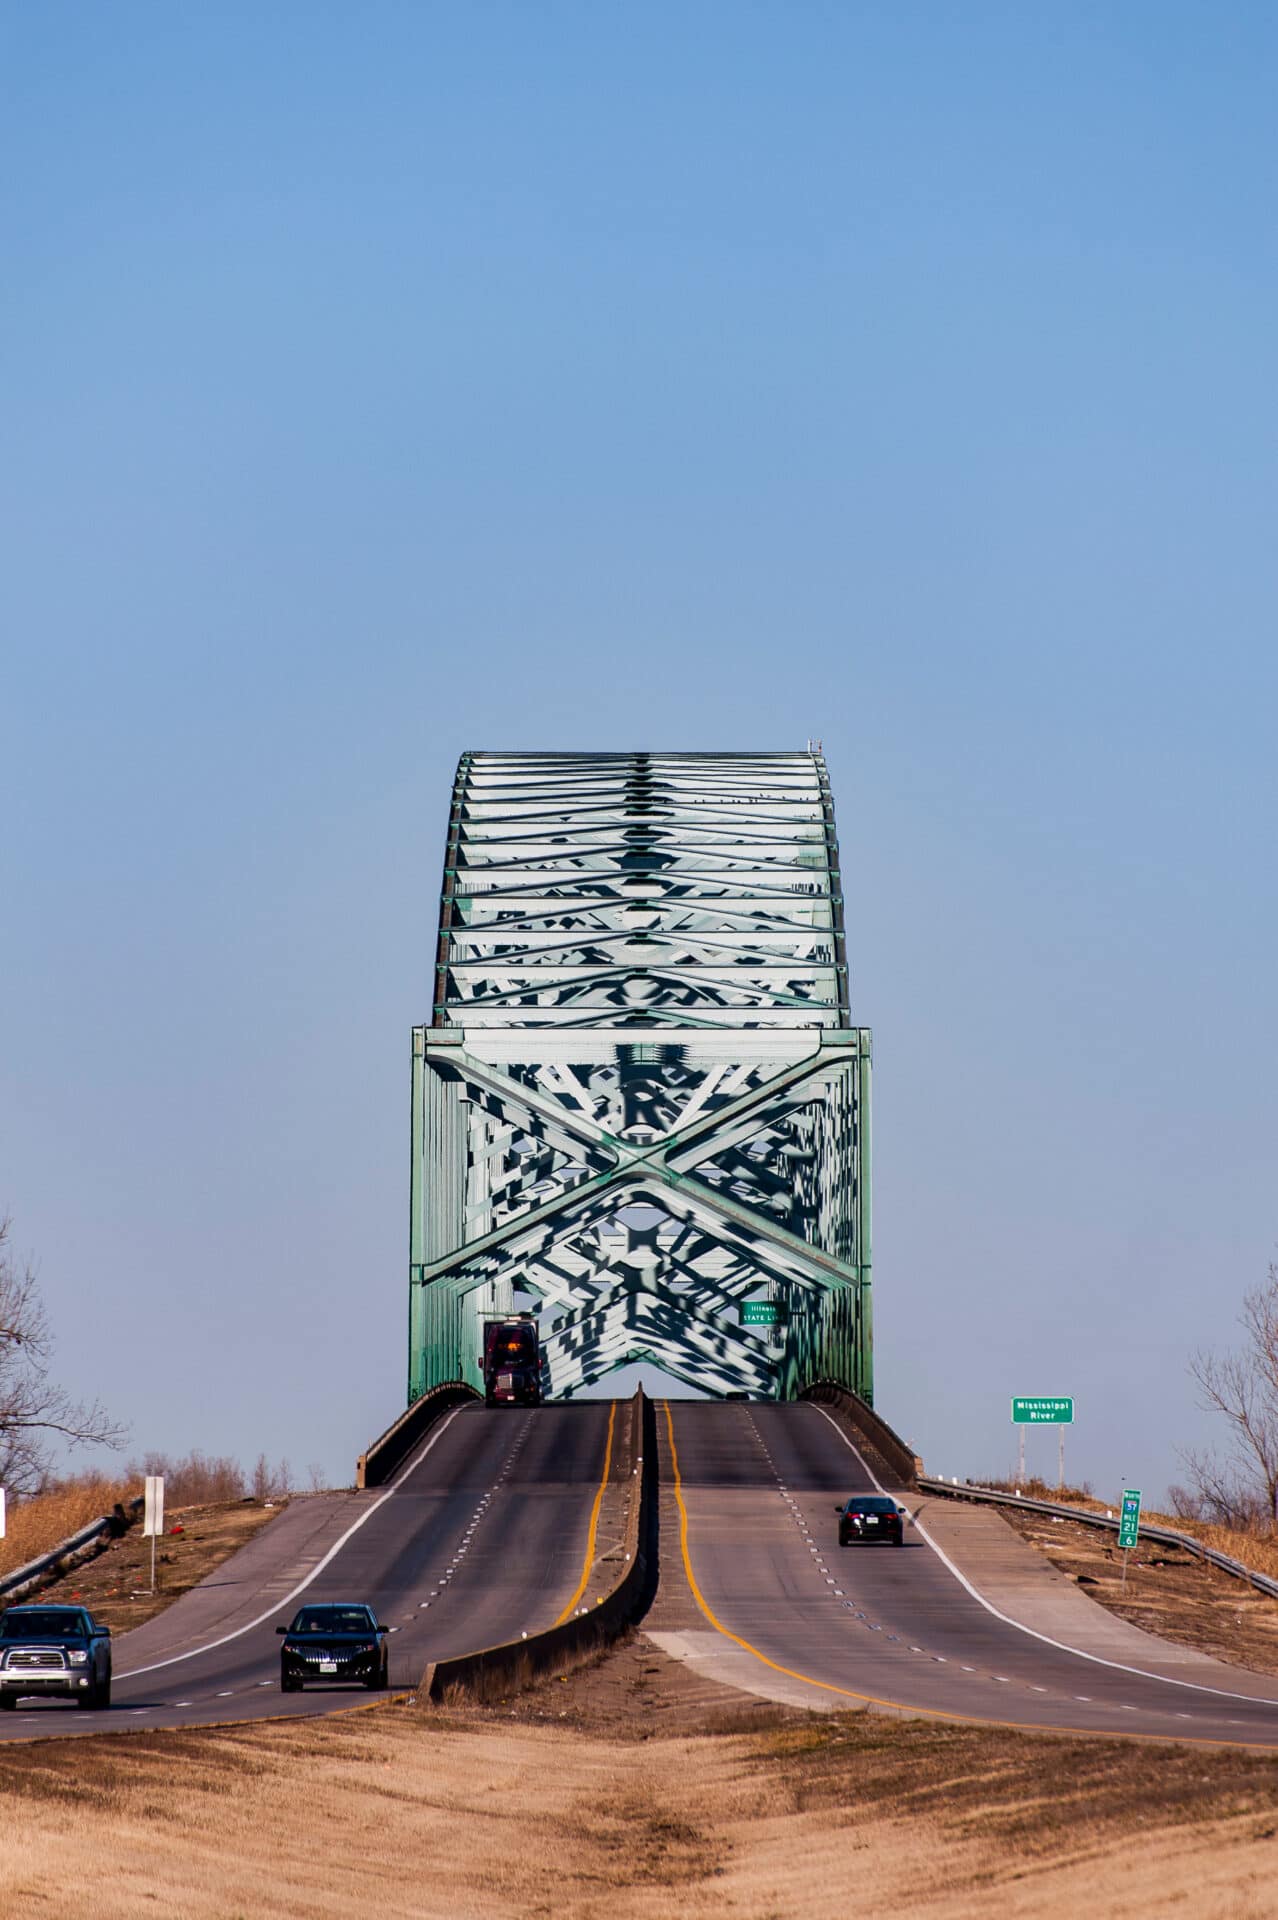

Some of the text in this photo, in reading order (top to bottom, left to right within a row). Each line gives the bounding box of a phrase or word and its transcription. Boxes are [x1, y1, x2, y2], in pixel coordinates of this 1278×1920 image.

[1017, 1401, 1069, 1410] Mississippi
[1030, 1411, 1055, 1420] River
[1127, 1503, 1137, 1511] 57
[1124, 1514, 1136, 1522] MILE
[1124, 1522, 1135, 1532] 21
